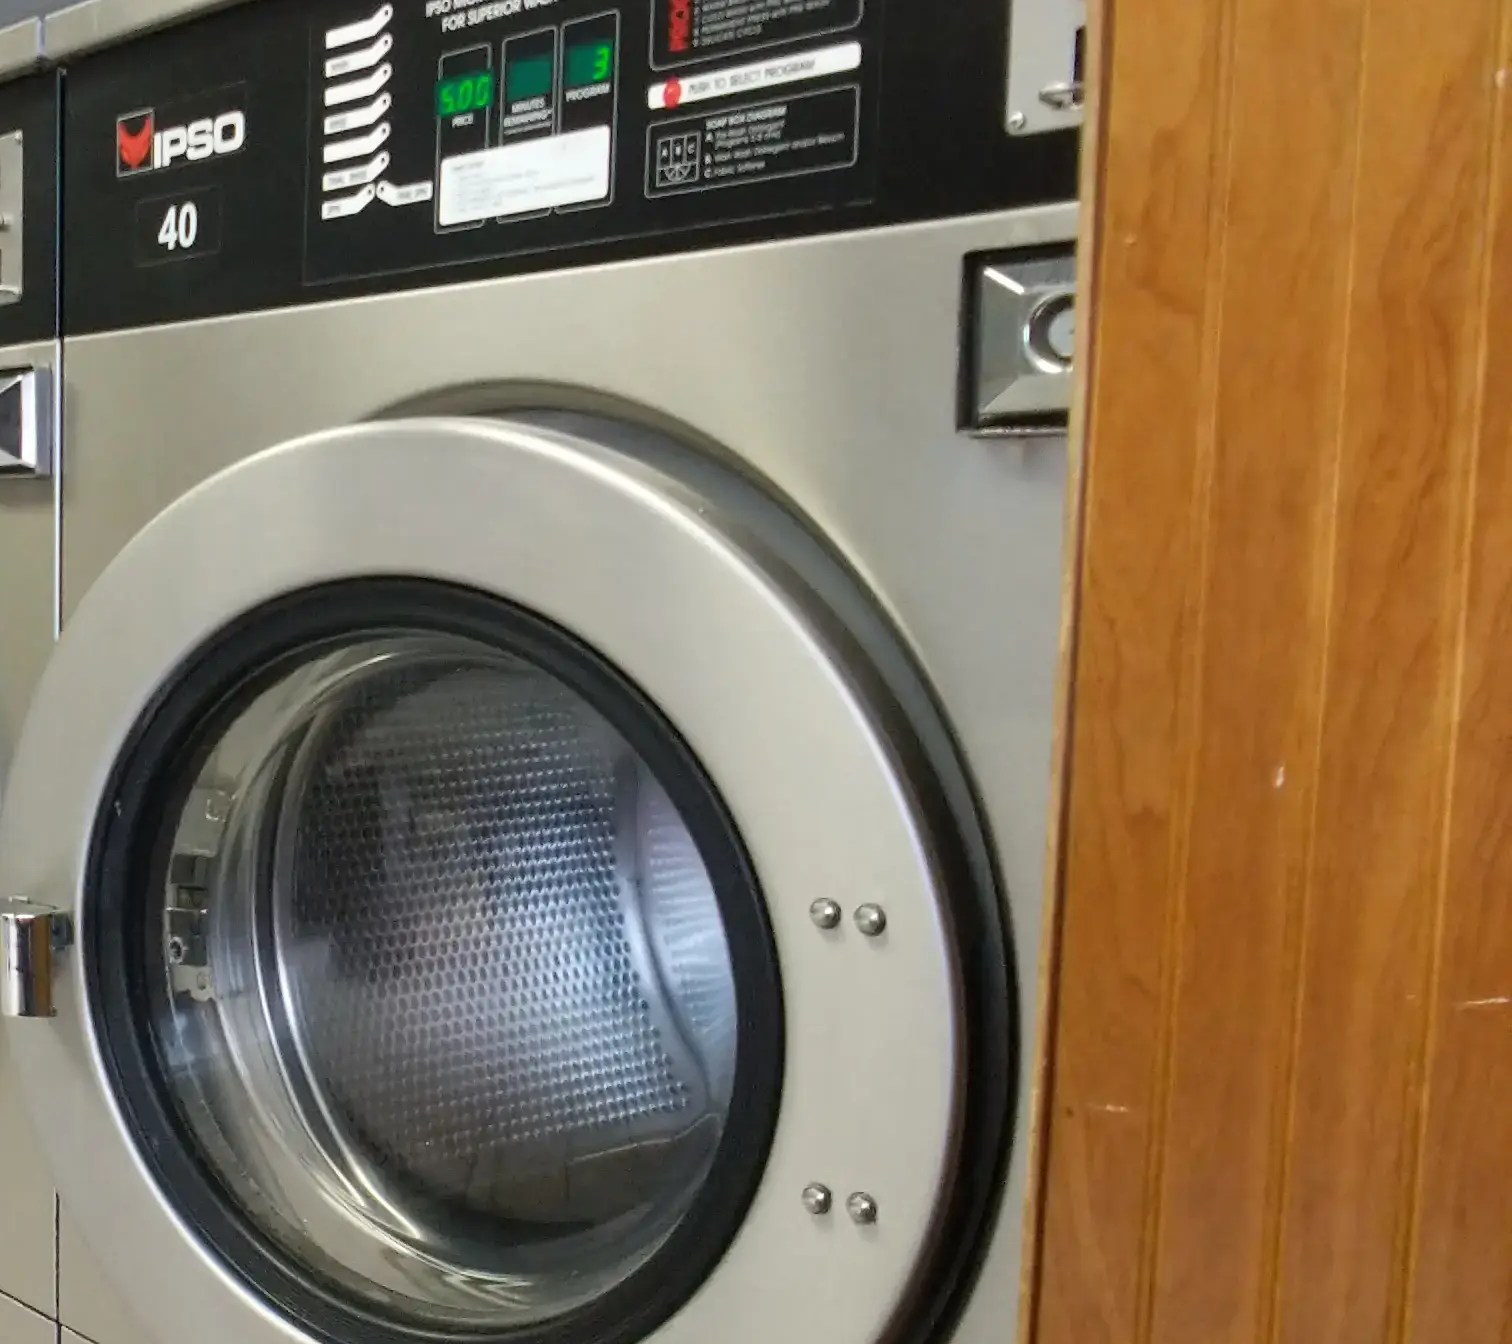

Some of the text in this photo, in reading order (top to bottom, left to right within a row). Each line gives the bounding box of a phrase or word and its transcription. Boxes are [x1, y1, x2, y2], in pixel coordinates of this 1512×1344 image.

[441, 12, 466, 33] FOR
[592, 46, 610, 81] 3
[714, 77, 726, 90] TO
[764, 59, 816, 81] PROGRAM
[153, 109, 245, 169] IPSO
[157, 201, 198, 251] 40
